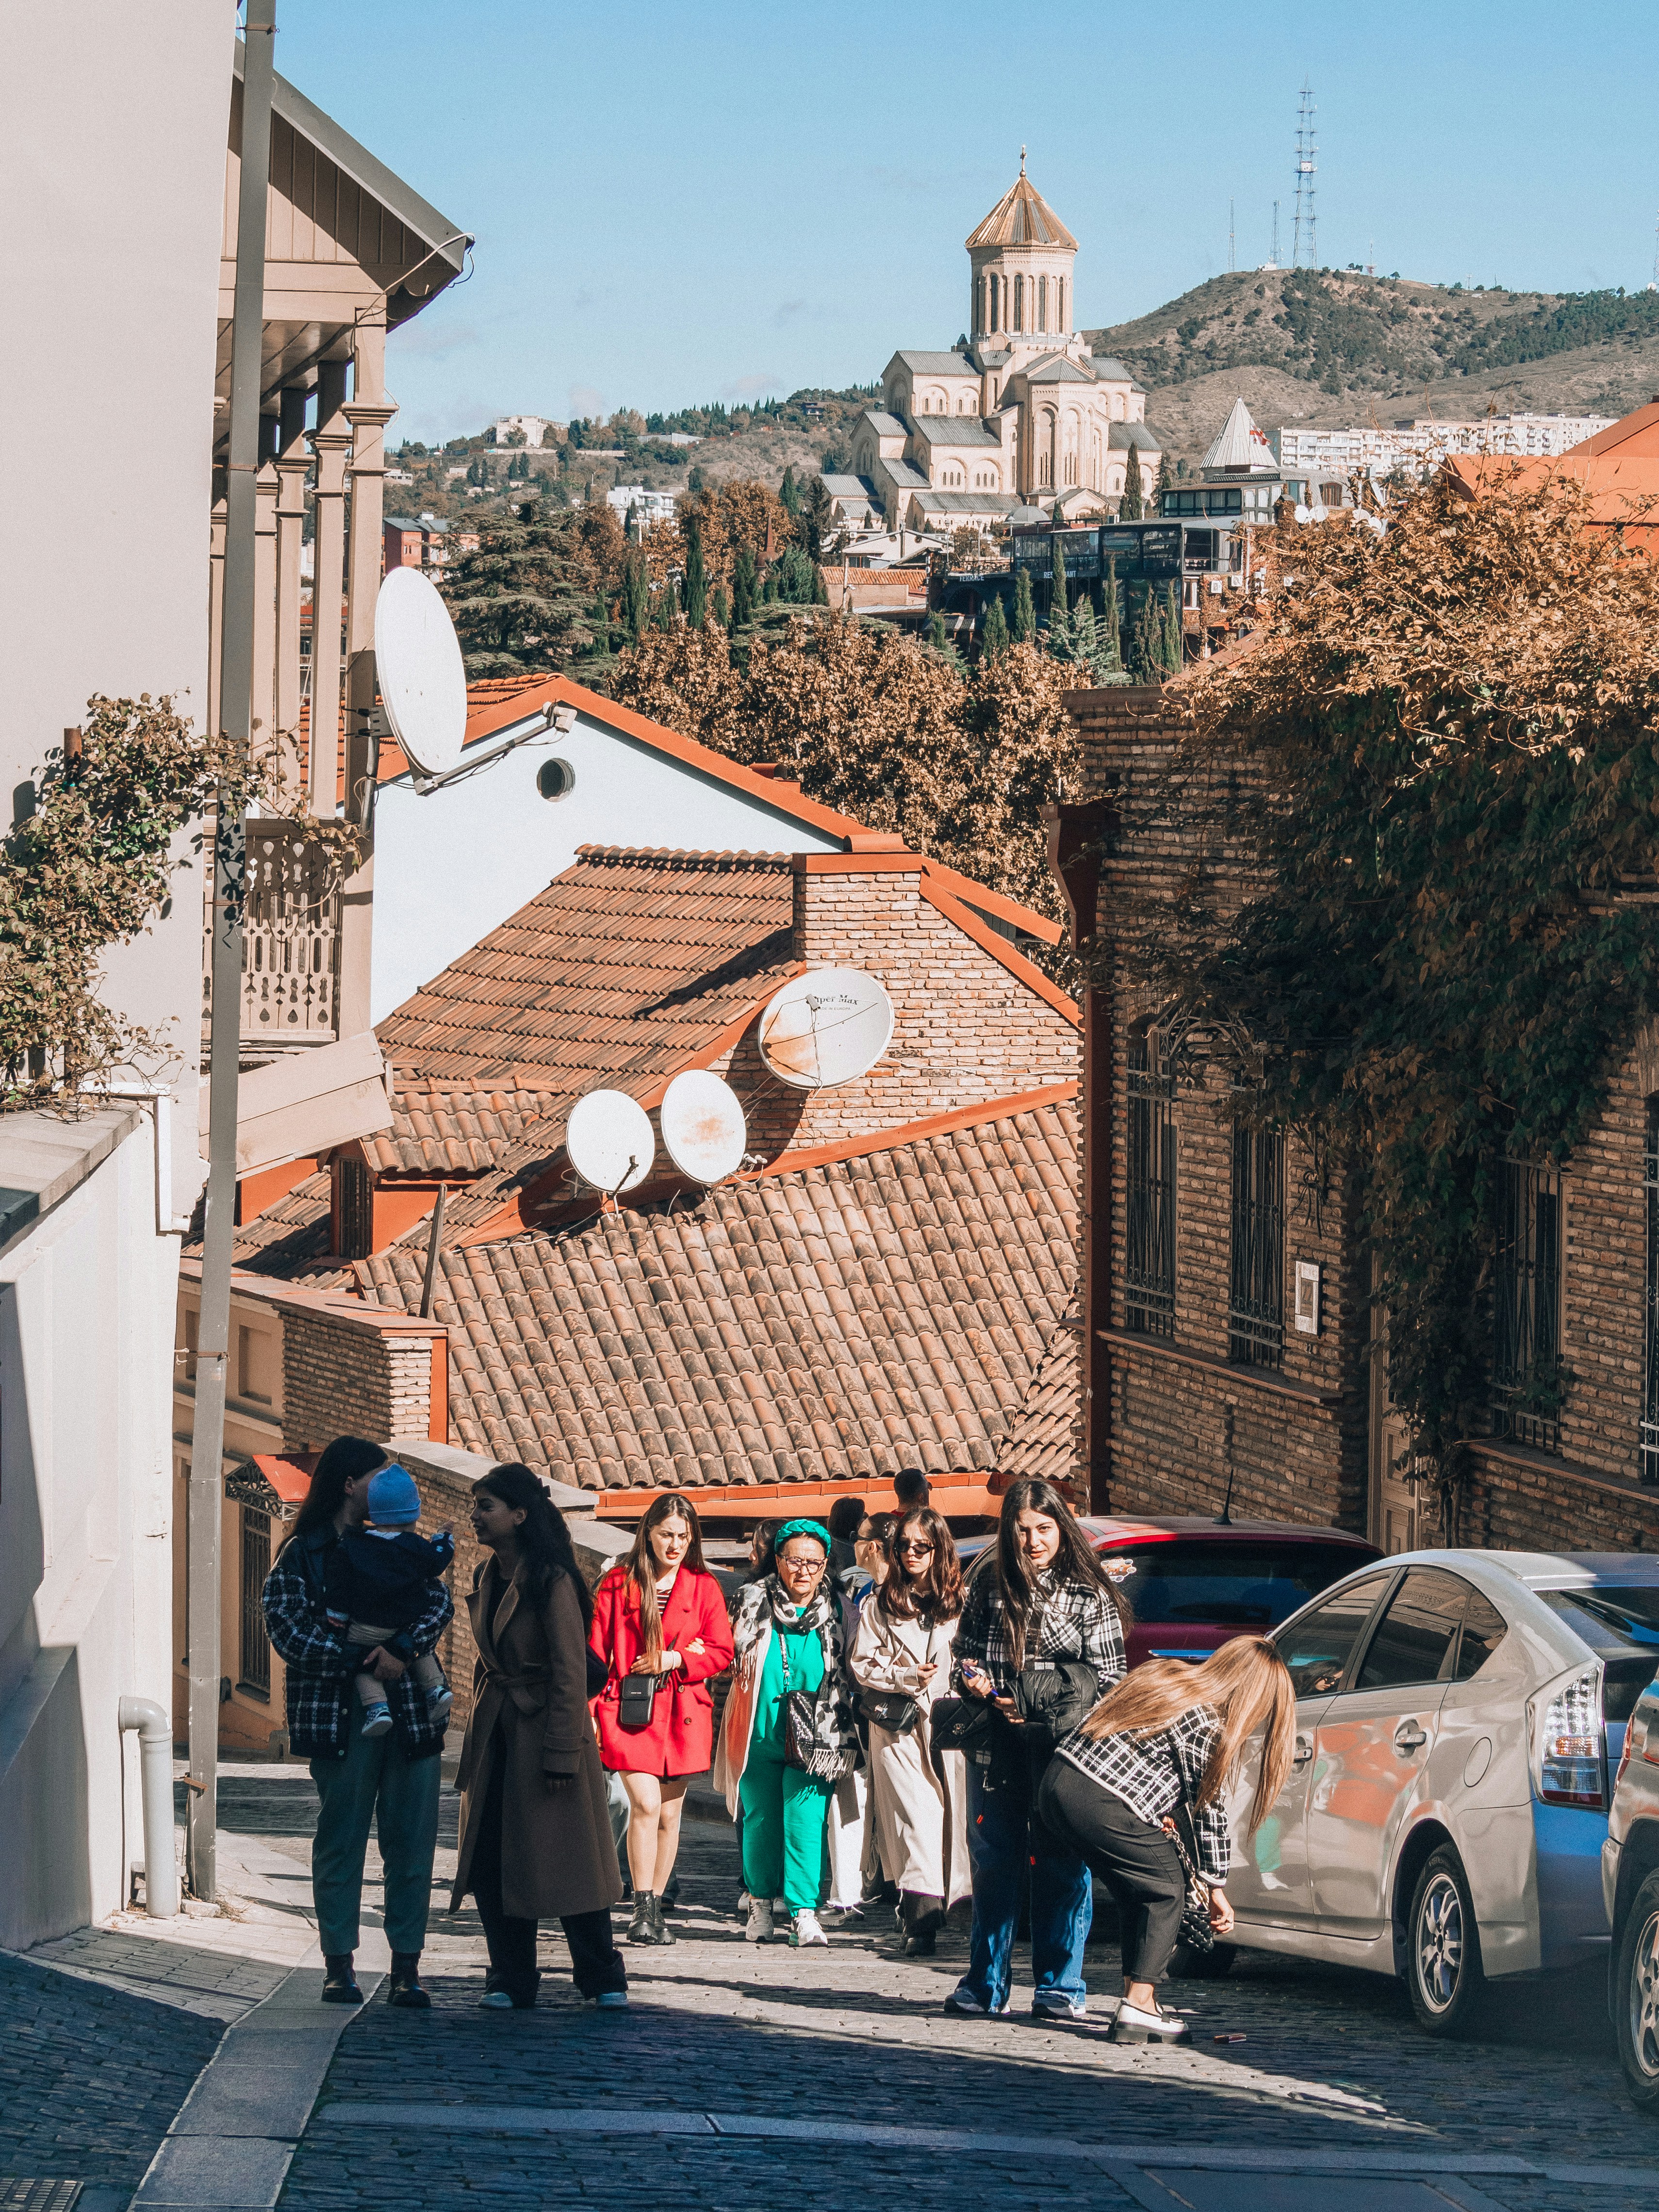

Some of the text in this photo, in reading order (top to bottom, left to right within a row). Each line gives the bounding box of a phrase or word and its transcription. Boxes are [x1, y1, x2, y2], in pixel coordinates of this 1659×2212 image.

[1043, 571, 1076, 579] RESANT
[816, 994, 857, 1005] per Max
